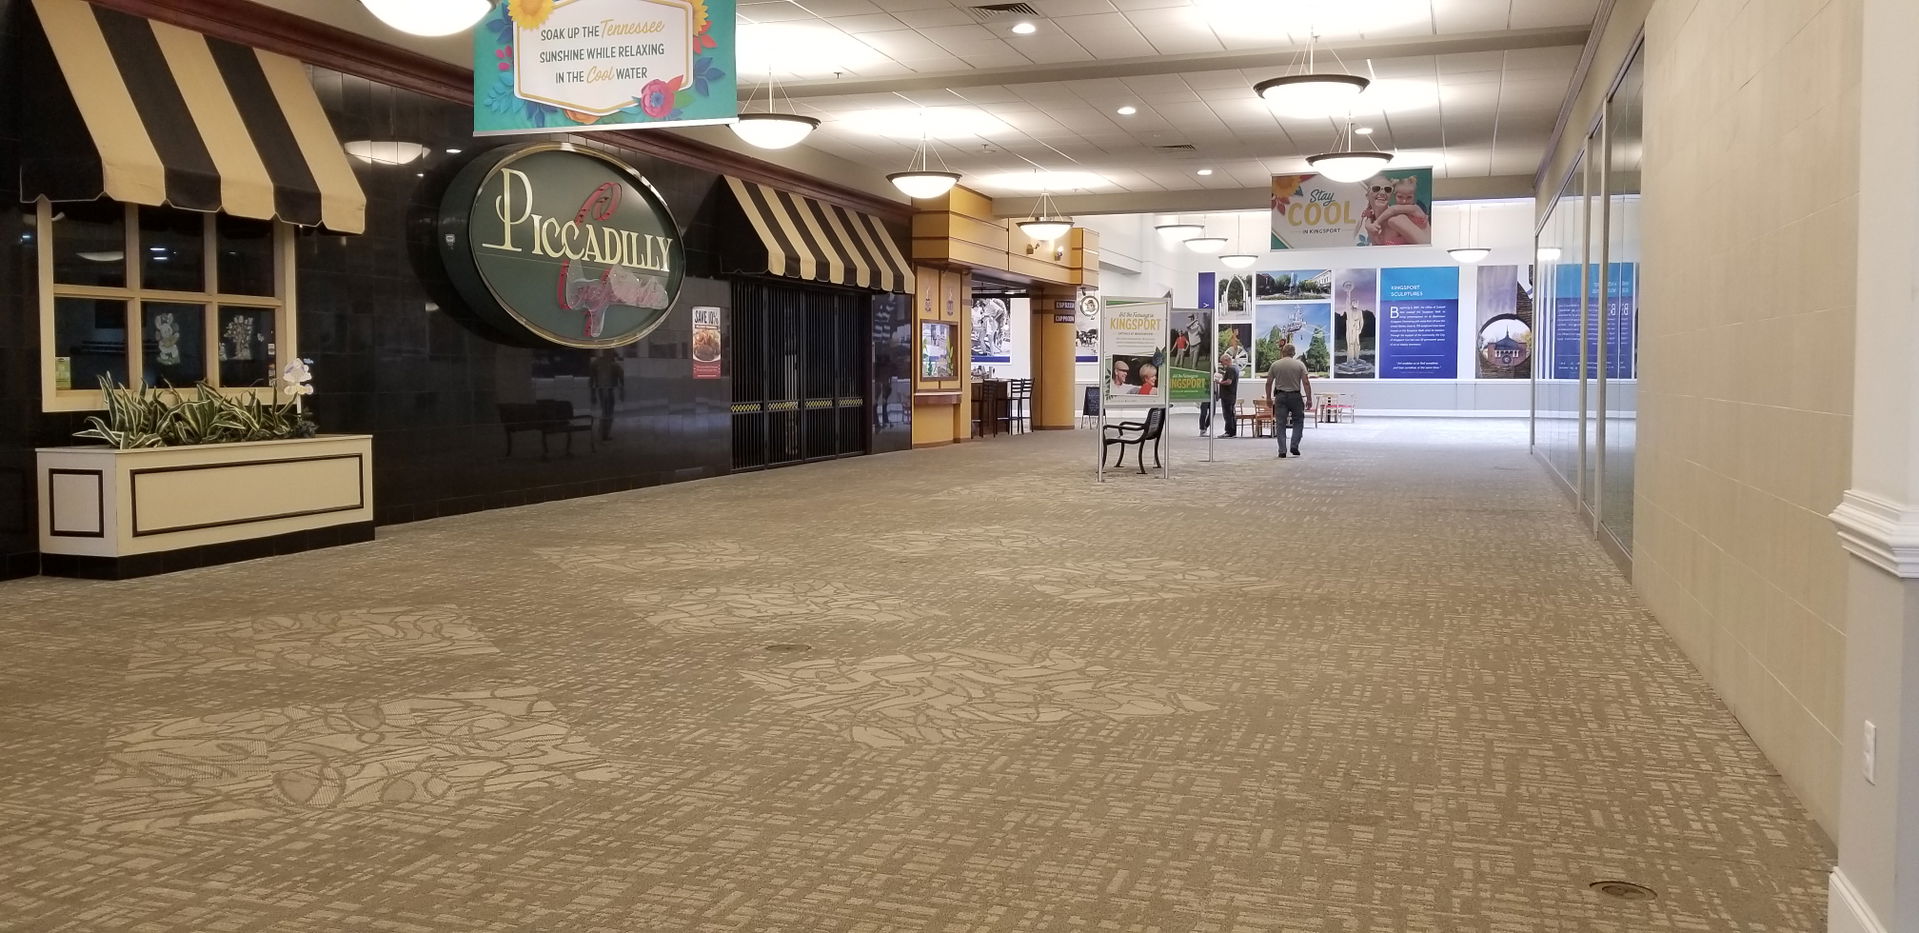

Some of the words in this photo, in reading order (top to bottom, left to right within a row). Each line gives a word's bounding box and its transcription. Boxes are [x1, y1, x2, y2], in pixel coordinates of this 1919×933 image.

[541, 28, 565, 41] SOAK
[567, 27, 580, 39] UP
[582, 26, 600, 38] THE
[600, 19, 665, 38] Tennessee
[539, 49, 585, 63] SUNSHINE
[586, 46, 616, 60] WHILE
[618, 43, 665, 57] RELAXING
[555, 71, 565, 84] IN
[566, 70, 584, 83] THE
[586, 65, 615, 84] Cool
[615, 66, 648, 80] WATER
[1310, 188, 1336, 206] Stay
[1288, 200, 1356, 227] COOL
[694, 310, 707, 324] SAVE
[708, 310, 719, 325] 10%
[1110, 318, 1161, 331] KINGSPORT
[1169, 377, 1206, 390] INGSPORT
